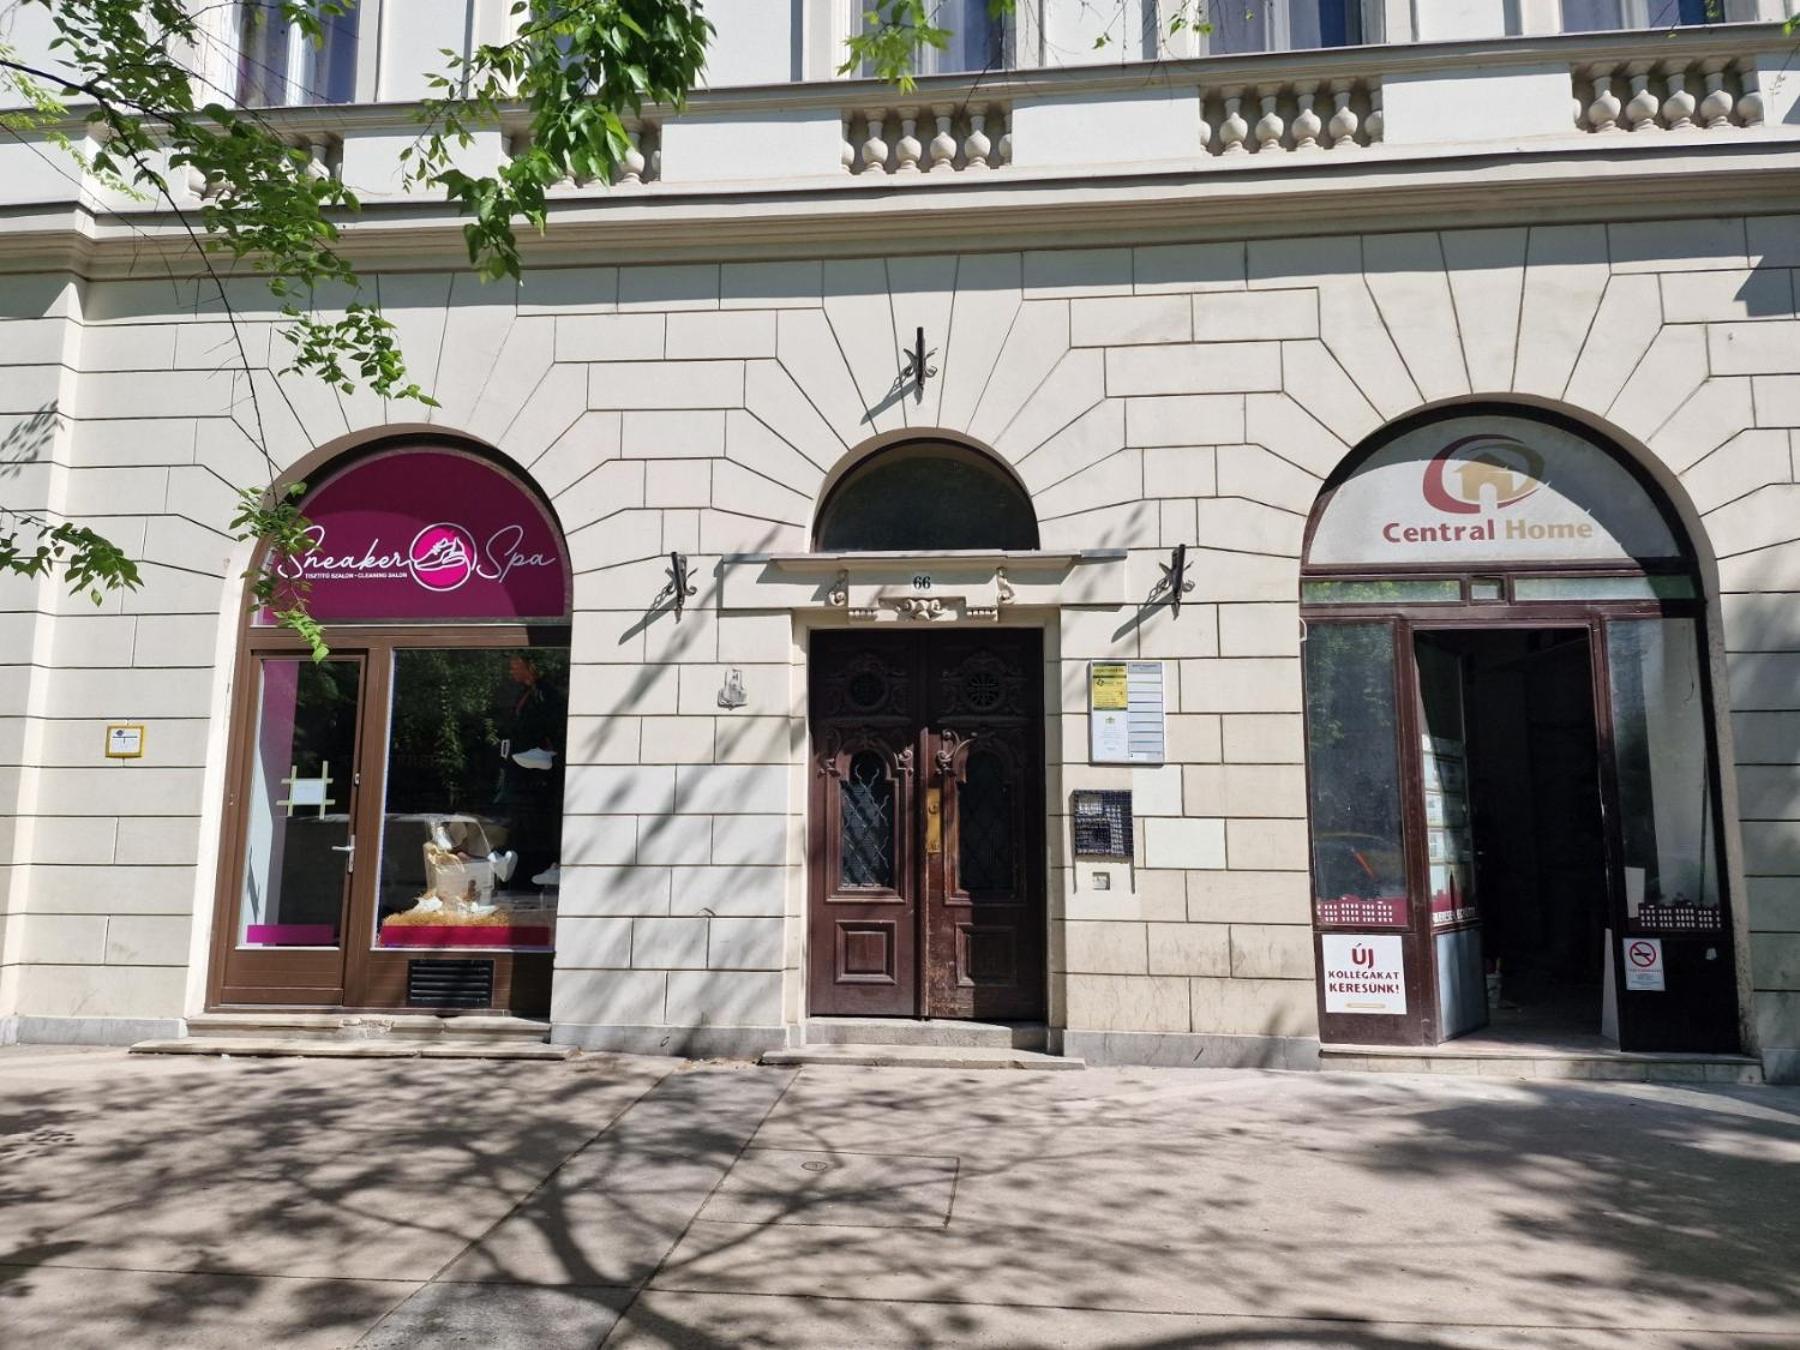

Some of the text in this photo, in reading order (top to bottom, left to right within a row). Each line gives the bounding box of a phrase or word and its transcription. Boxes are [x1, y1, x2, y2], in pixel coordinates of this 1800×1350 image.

[1382, 518, 1593, 543] Central Home
[277, 525, 556, 583] Sneaker Spa
[912, 575, 931, 590] 66
[1351, 942, 1374, 969] ÚJ
